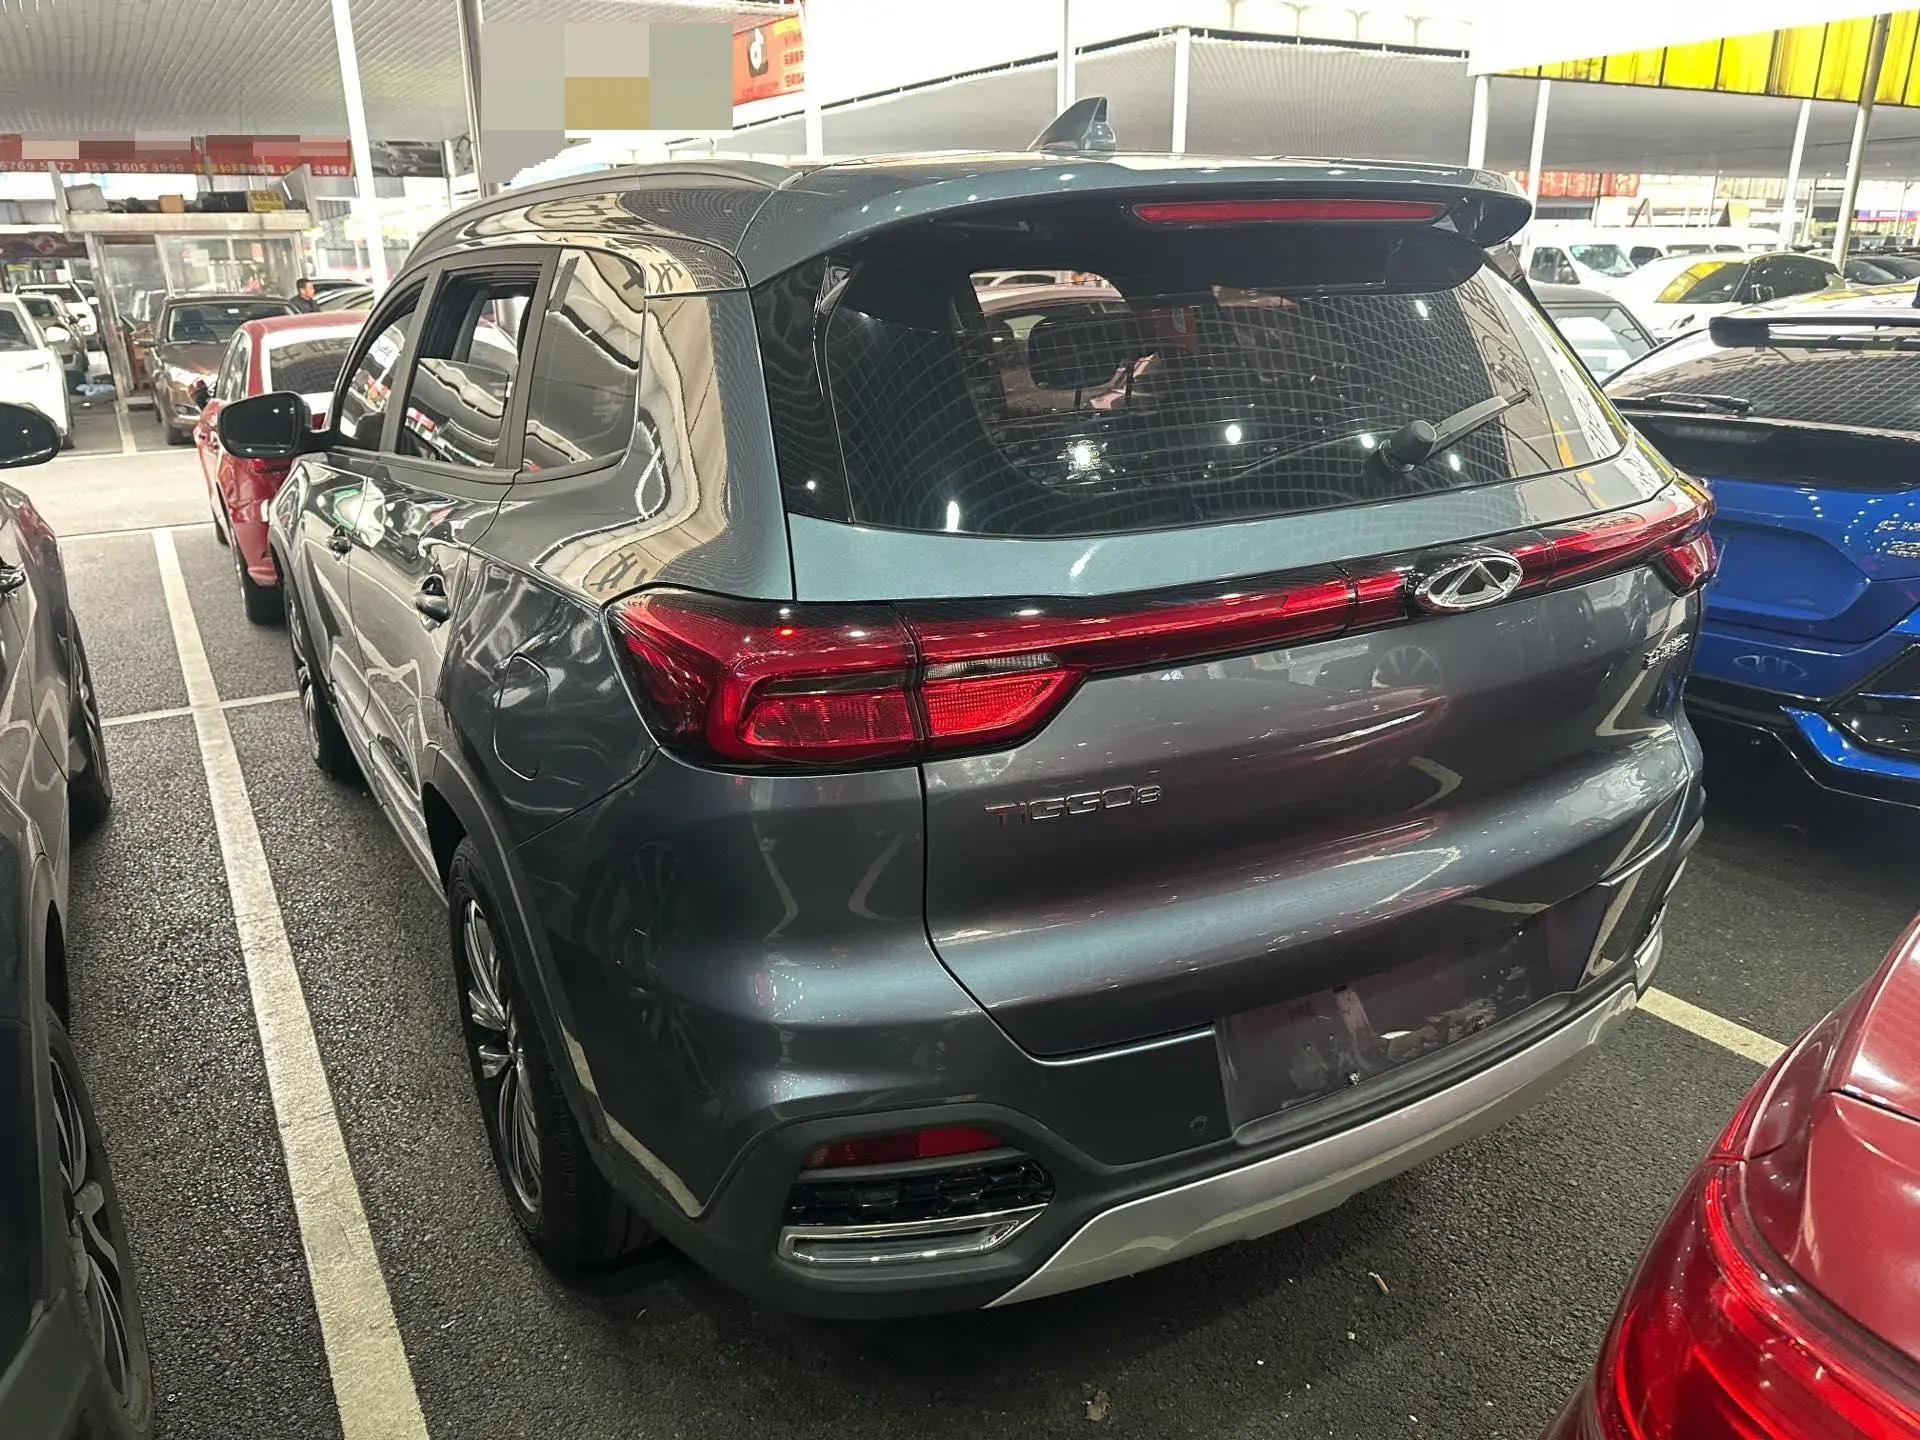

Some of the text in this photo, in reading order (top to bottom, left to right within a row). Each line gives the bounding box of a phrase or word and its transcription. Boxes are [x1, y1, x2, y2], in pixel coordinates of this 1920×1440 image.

[40, 161, 75, 172] 572
[84, 162, 109, 172] 158
[113, 162, 148, 173] 2605
